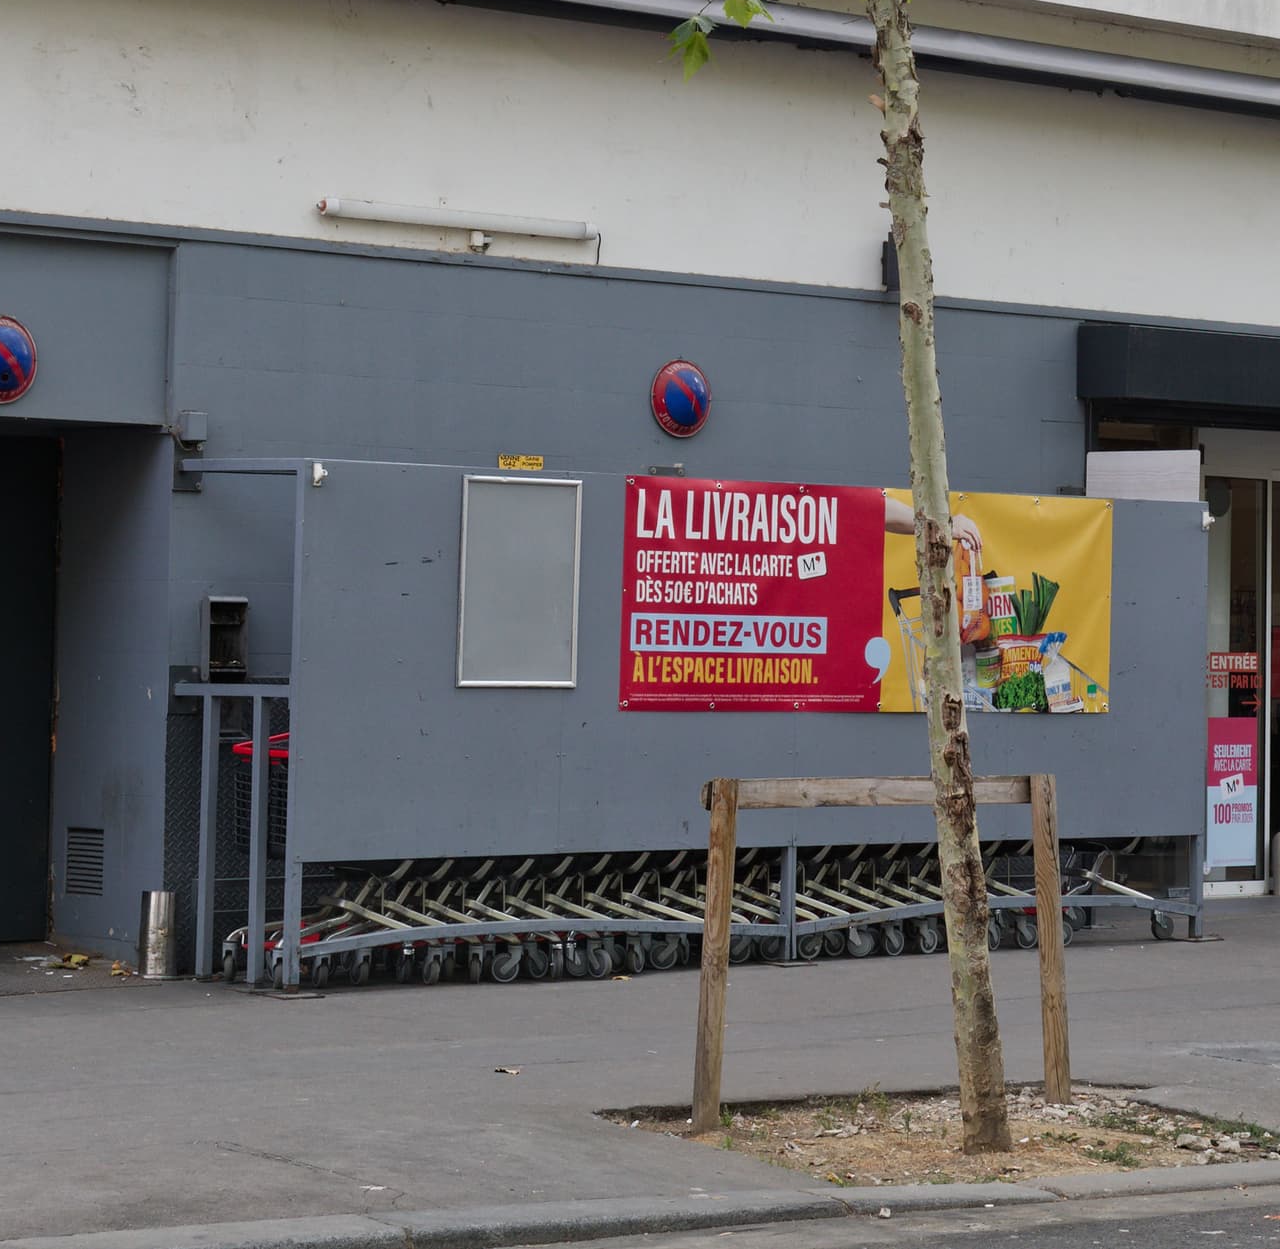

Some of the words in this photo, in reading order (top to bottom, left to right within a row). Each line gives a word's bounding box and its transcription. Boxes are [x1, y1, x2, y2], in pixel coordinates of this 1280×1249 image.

[636, 488, 675, 540] LA
[685, 490, 838, 544] LIVRAISON
[700, 552, 732, 576] AVEC
[734, 553, 755, 576] LA
[755, 554, 793, 577] CARTE
[636, 575, 662, 603] DÈS
[665, 581, 693, 603] 50€
[696, 582, 758, 605] D'ACHATS
[635, 618, 822, 648] RENDEZ-VOUS
[632, 650, 645, 683] À
[647, 656, 724, 684] L'ESPACE
[727, 658, 818, 684] LIVRAISON.
[1231, 675, 1248, 688] PAR
[1214, 744, 1252, 758] SEULEMENT
[1214, 759, 1227, 771] AVEC
[1228, 759, 1235, 771] LA
[1235, 759, 1252, 771] CARTE
[1213, 803, 1231, 824] 100
